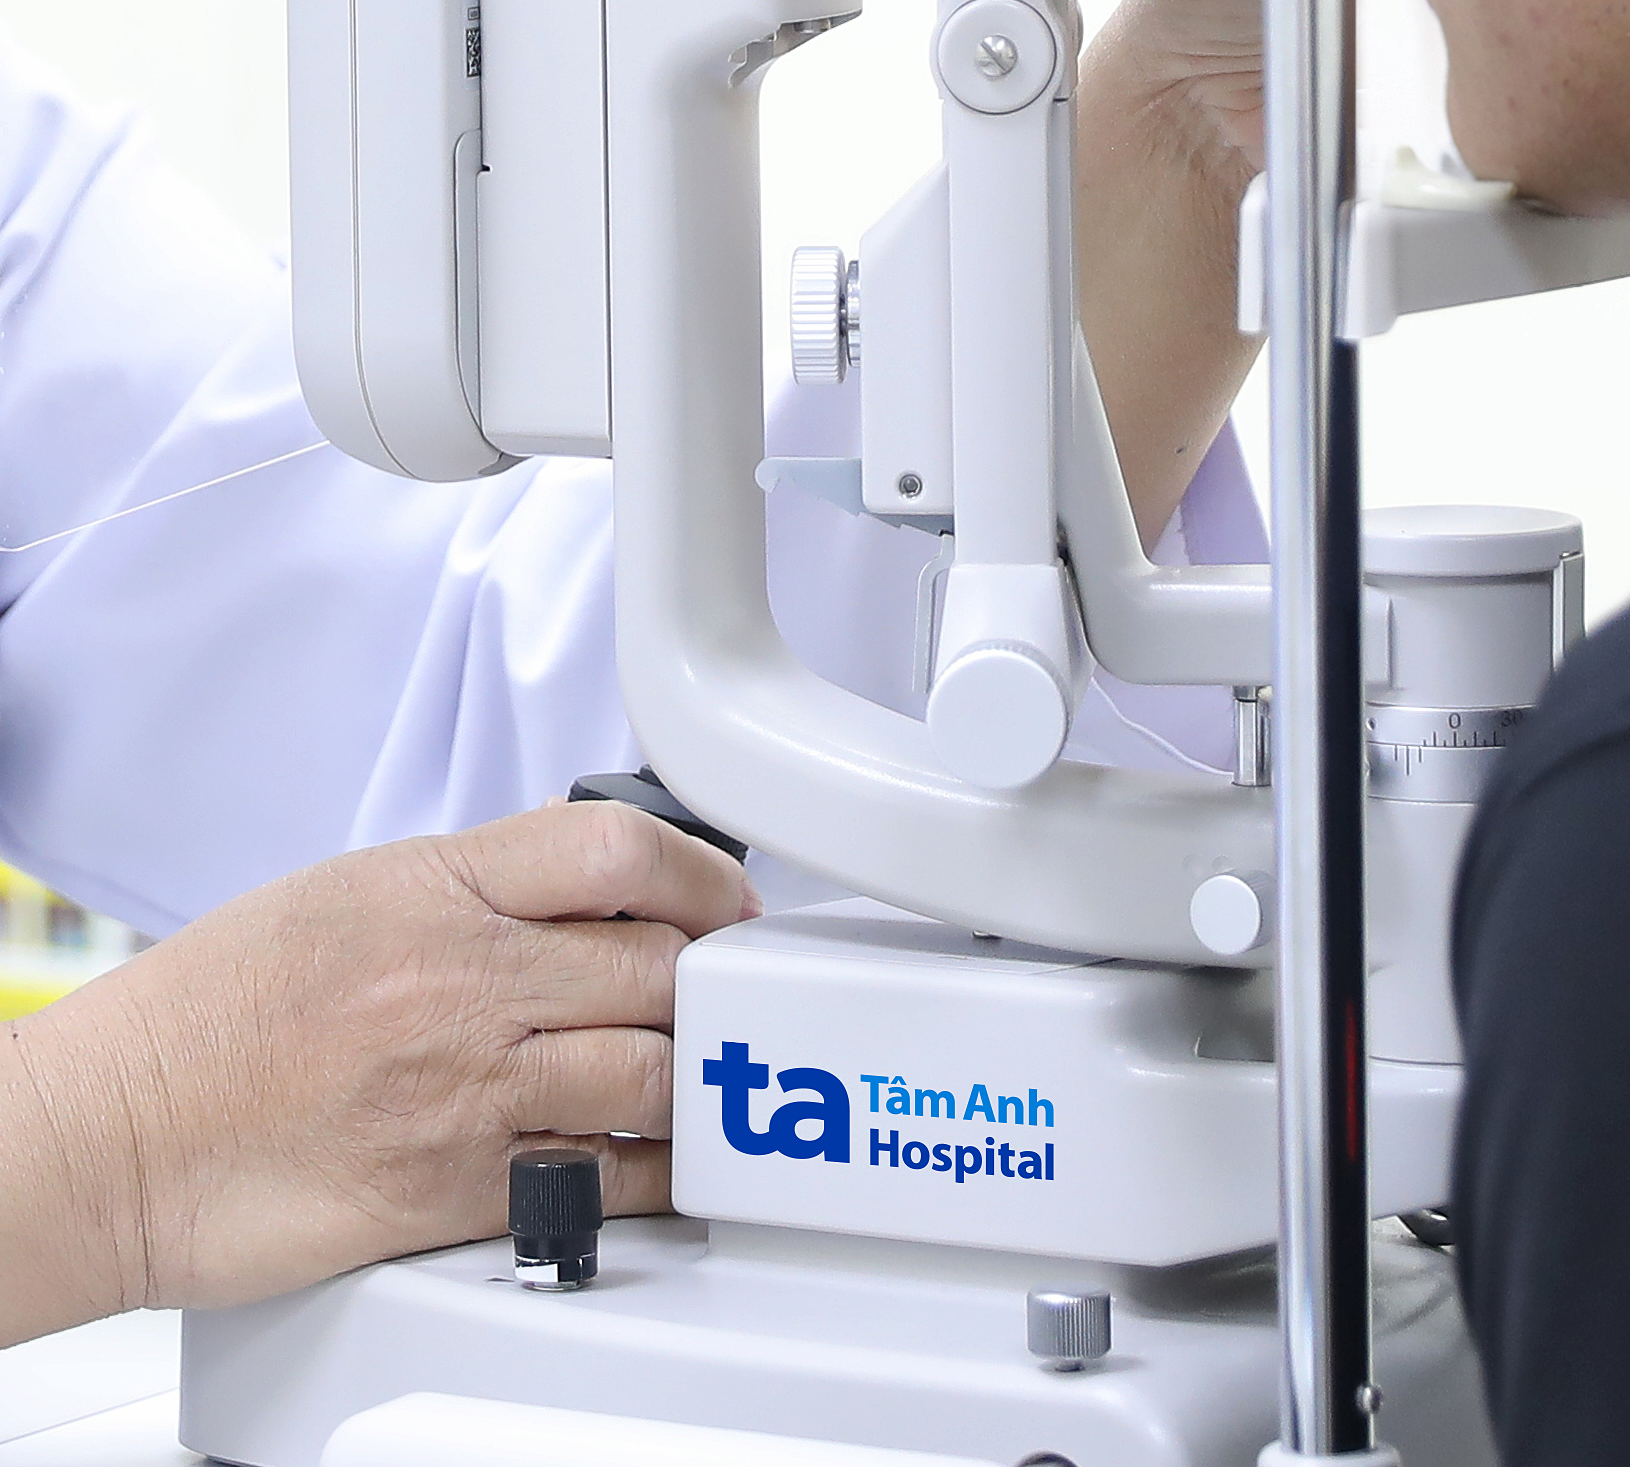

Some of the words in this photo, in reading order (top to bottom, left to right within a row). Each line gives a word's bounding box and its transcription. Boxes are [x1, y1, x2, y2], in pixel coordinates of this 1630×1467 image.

[1448, 712, 1461, 729] 0
[702, 1041, 851, 1164] ta
[860, 1074, 956, 1120] Tâm
[963, 1083, 1055, 1128] Anh
[869, 1128, 1055, 1184] Hospital
